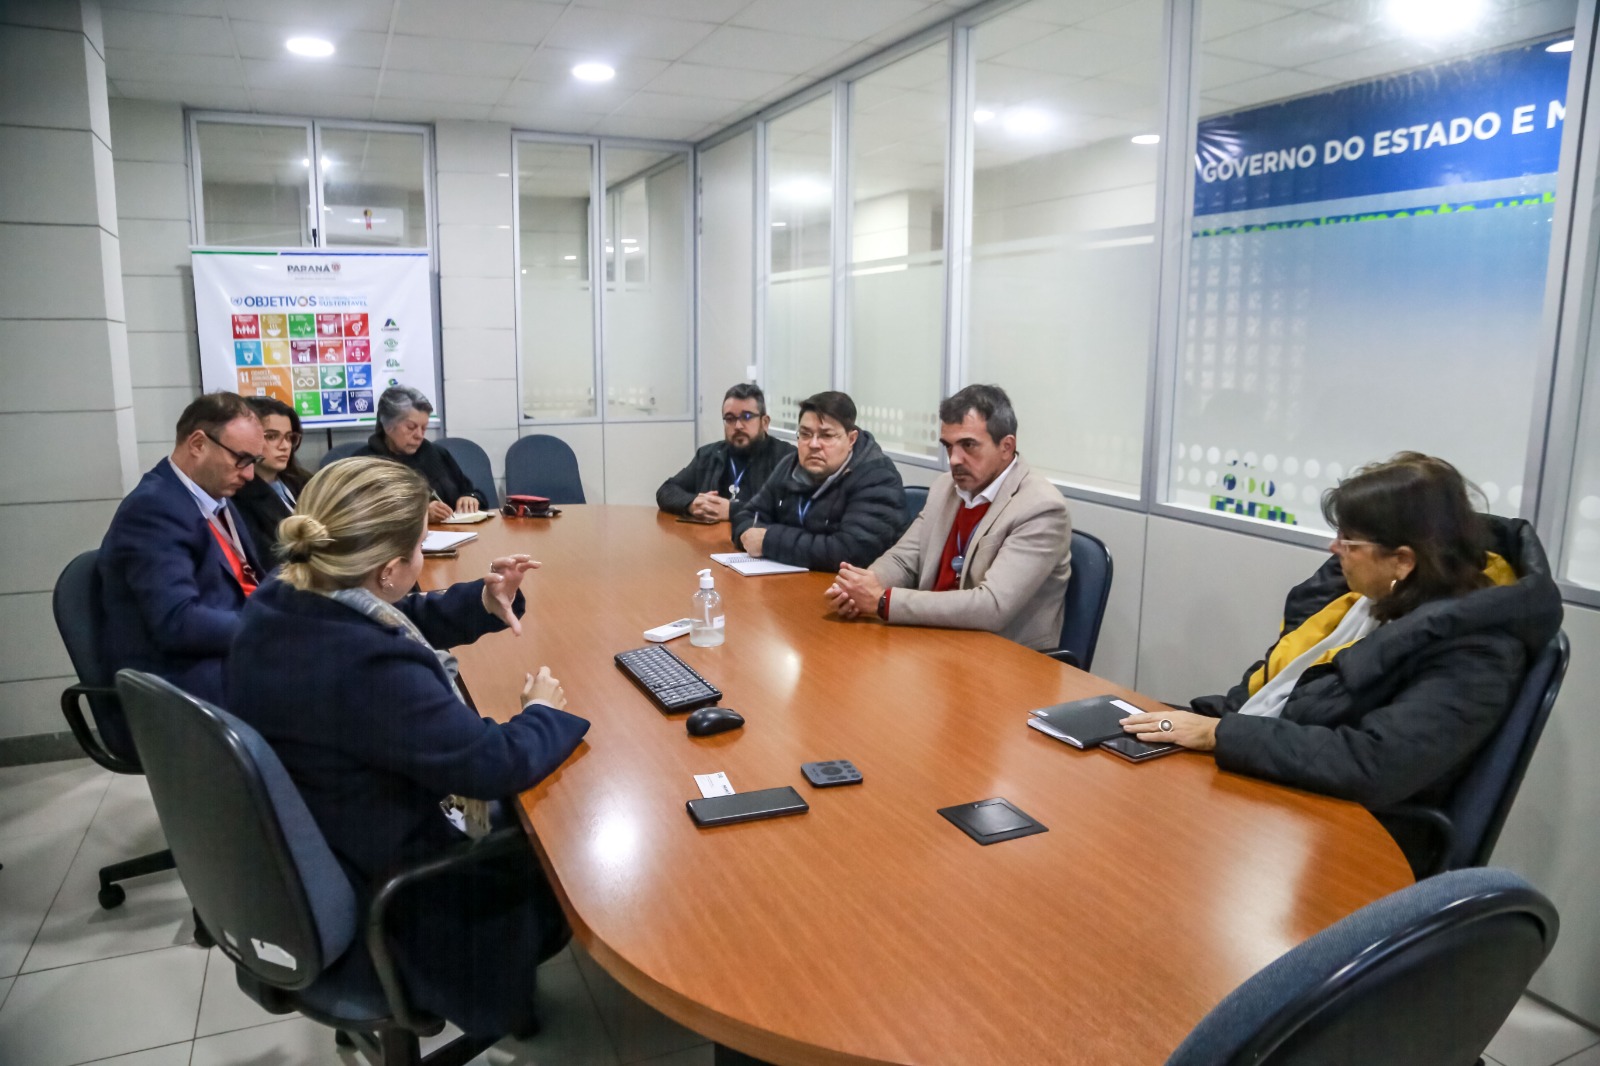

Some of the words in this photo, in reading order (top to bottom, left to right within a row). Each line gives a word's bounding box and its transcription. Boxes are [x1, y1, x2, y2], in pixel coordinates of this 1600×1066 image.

[1202, 144, 1317, 183] GOVERNO
[1324, 136, 1365, 165] DO
[1373, 111, 1502, 157] ESTADO
[1511, 104, 1536, 135] E
[244, 295, 317, 308] OBJETIVOS
